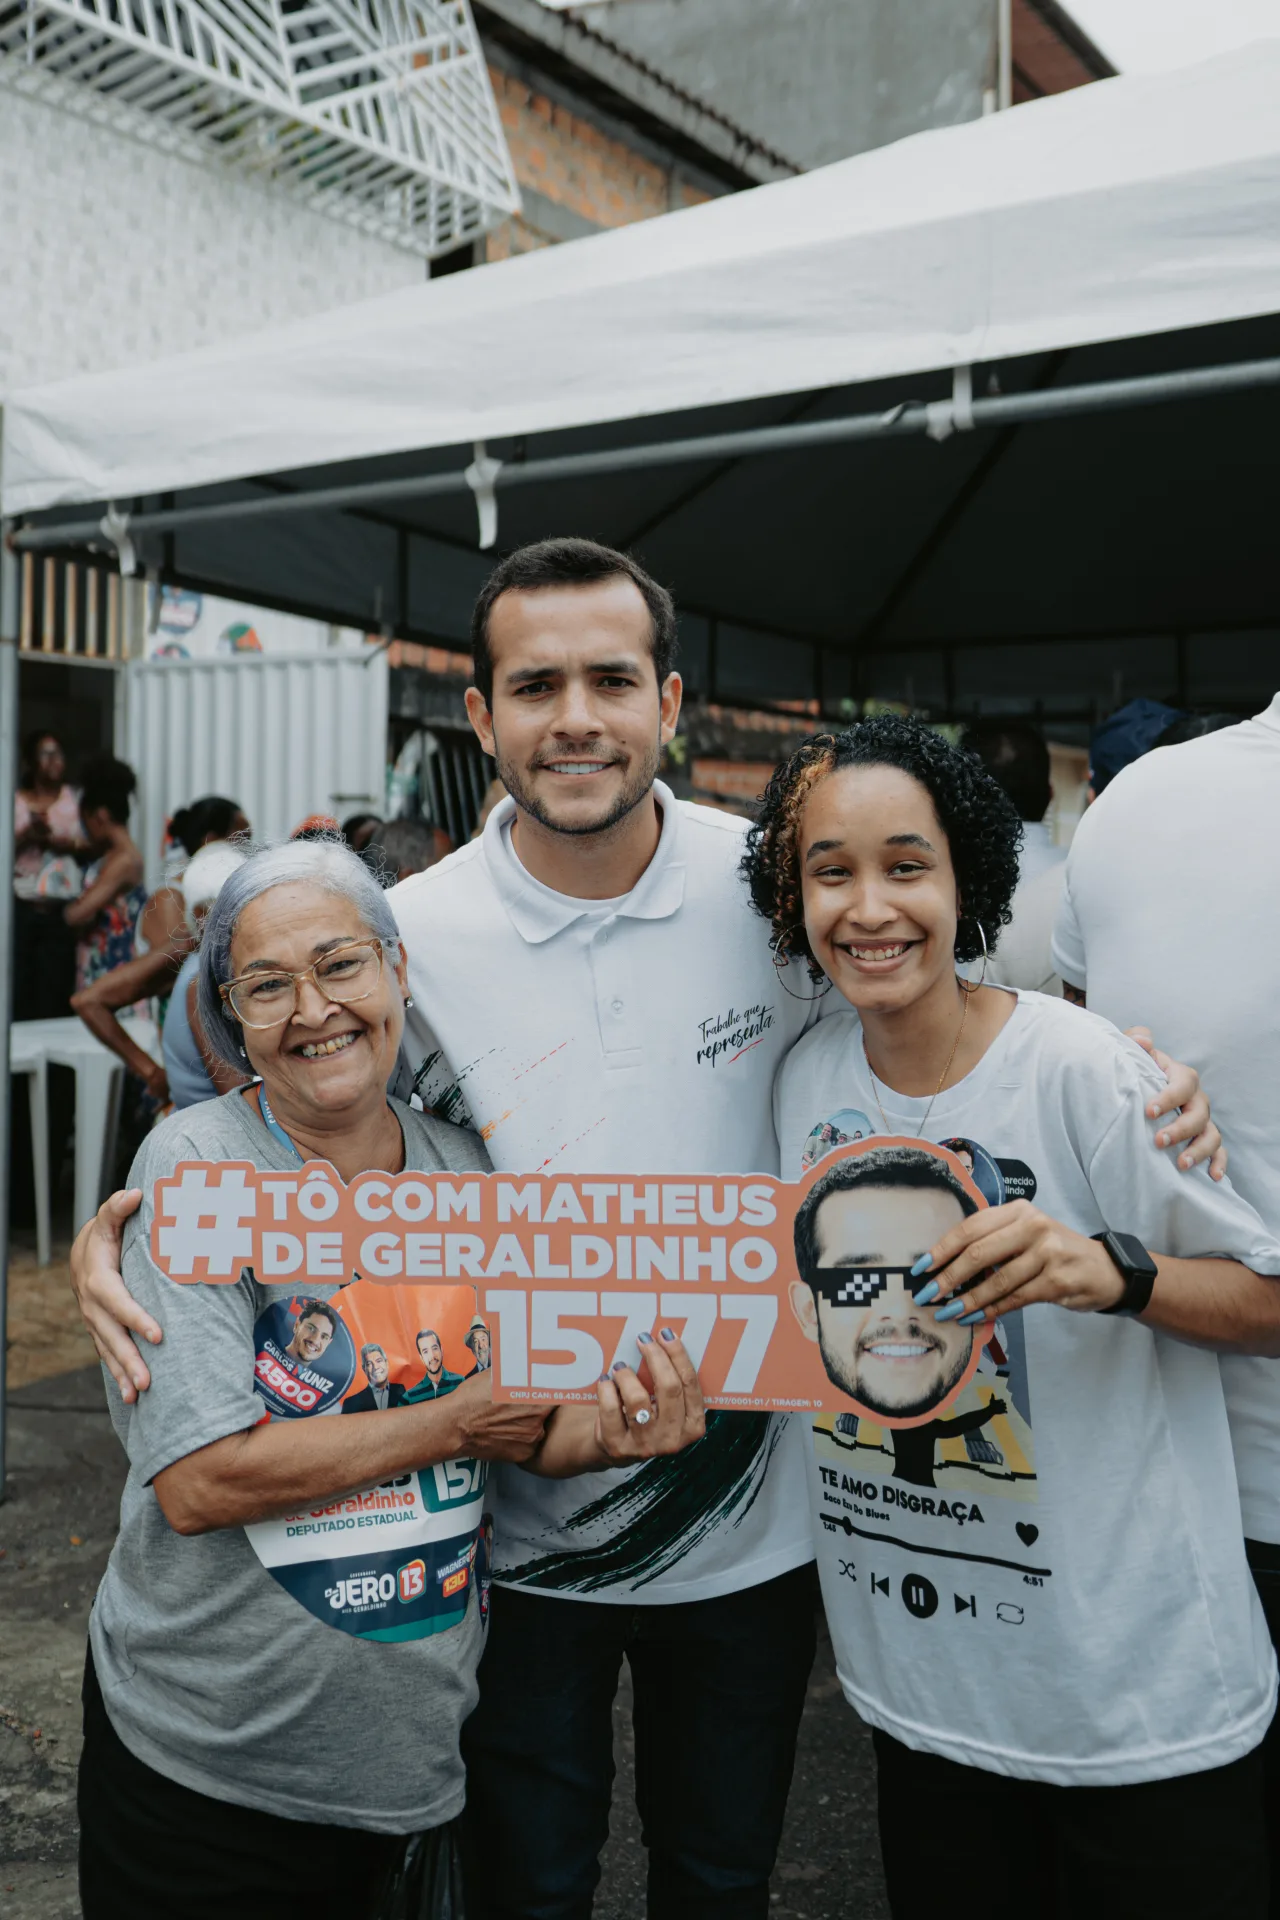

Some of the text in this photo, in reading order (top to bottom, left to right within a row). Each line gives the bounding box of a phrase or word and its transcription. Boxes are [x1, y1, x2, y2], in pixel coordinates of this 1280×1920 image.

[698, 1005, 760, 1043] Trabalho que
[354, 1180, 481, 1222] COM
[497, 1182, 777, 1226] MATHEUS
[262, 1231, 778, 1283] DE GERALDINHO
[263, 1341, 294, 1372] CARLOS
[485, 1289, 778, 1394] 15777
[255, 1358, 316, 1407] 4500
[510, 1391, 530, 1399] CNPJ
[818, 1466, 985, 1526] TE AMO DISGRAÇA
[823, 1491, 841, 1505] Baco
[853, 1504, 864, 1515] Do
[865, 1508, 891, 1521] Blues
[286, 1510, 418, 1537] DEPUTADO ESTADUAL
[326, 1566, 423, 1609] JERO 13
[444, 1569, 466, 1594] 130
[1022, 1575, 1044, 1587] 4:51
